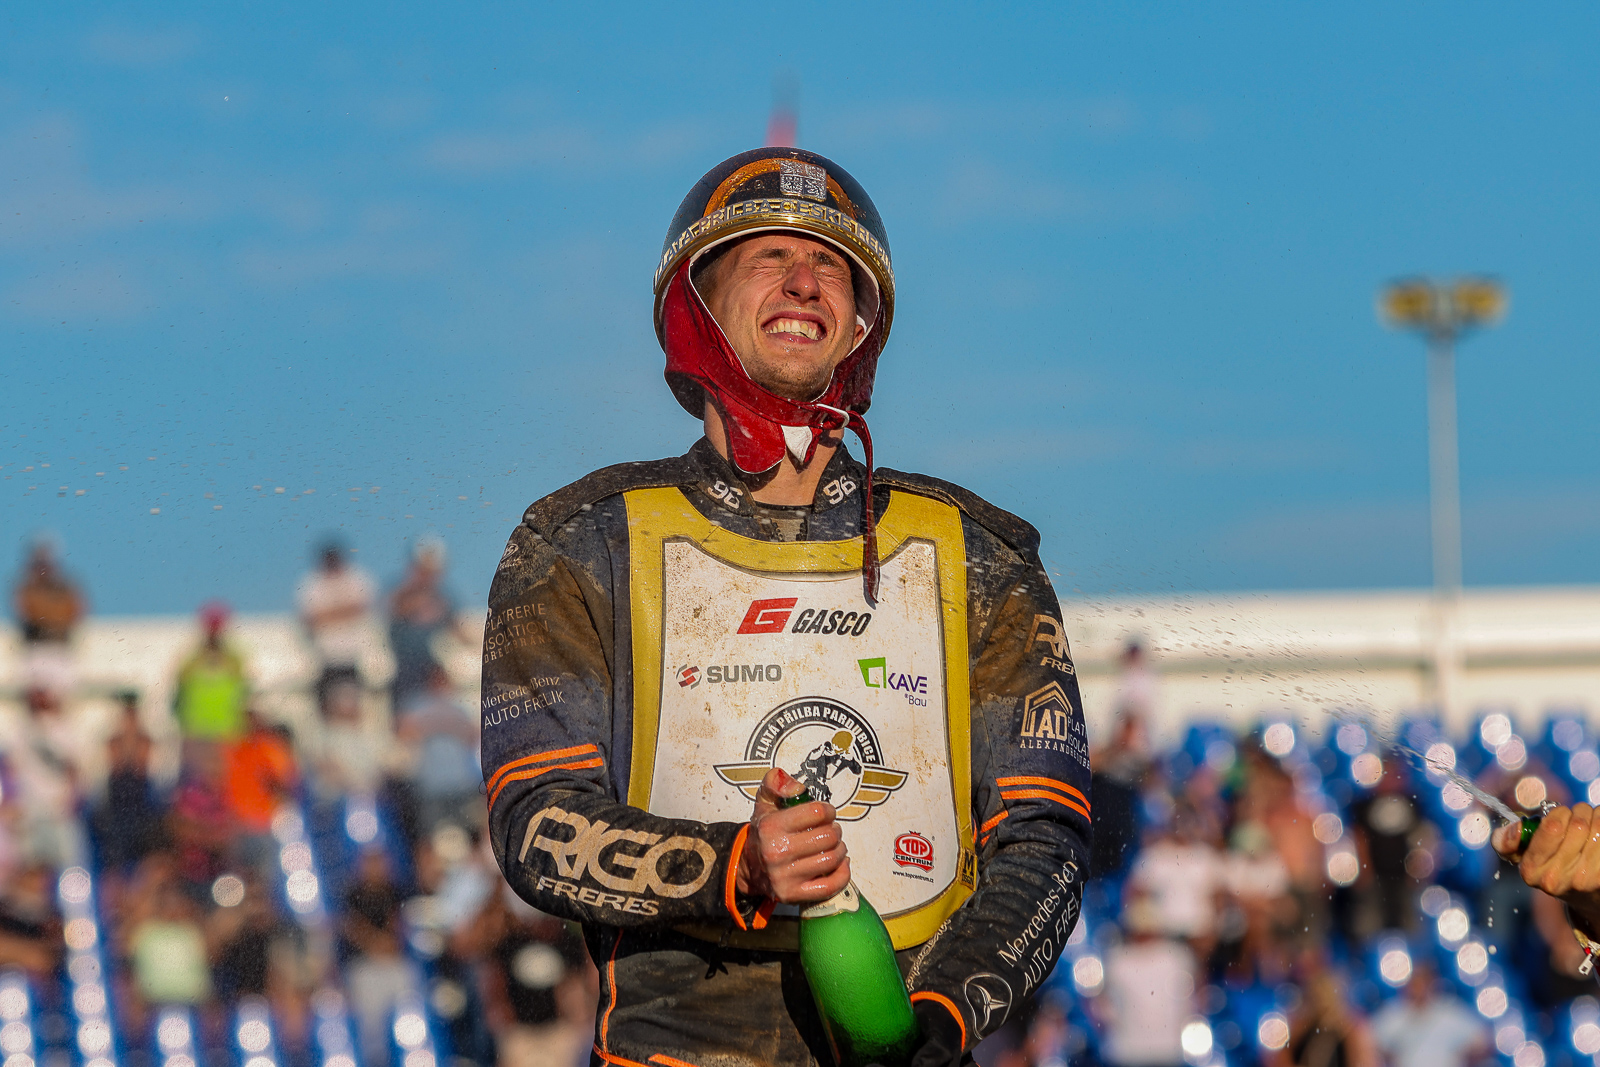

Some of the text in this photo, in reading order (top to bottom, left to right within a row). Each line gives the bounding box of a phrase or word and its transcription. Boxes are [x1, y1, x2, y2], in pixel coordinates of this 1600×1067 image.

[707, 480, 744, 510] 96
[822, 475, 857, 506] 96
[791, 608, 872, 637] GASCO
[706, 664, 782, 684] SUMO
[887, 672, 928, 694] KAVE
[484, 704, 520, 730] AUTO
[755, 705, 877, 763] ZLATÁ PŘILBA PARDUBICE
[518, 806, 718, 899] RIGO
[895, 854, 933, 867] CENTRUM
[902, 839, 929, 856] TOP
[535, 875, 660, 917] FRERES
[1023, 938, 1054, 997] AUTO
